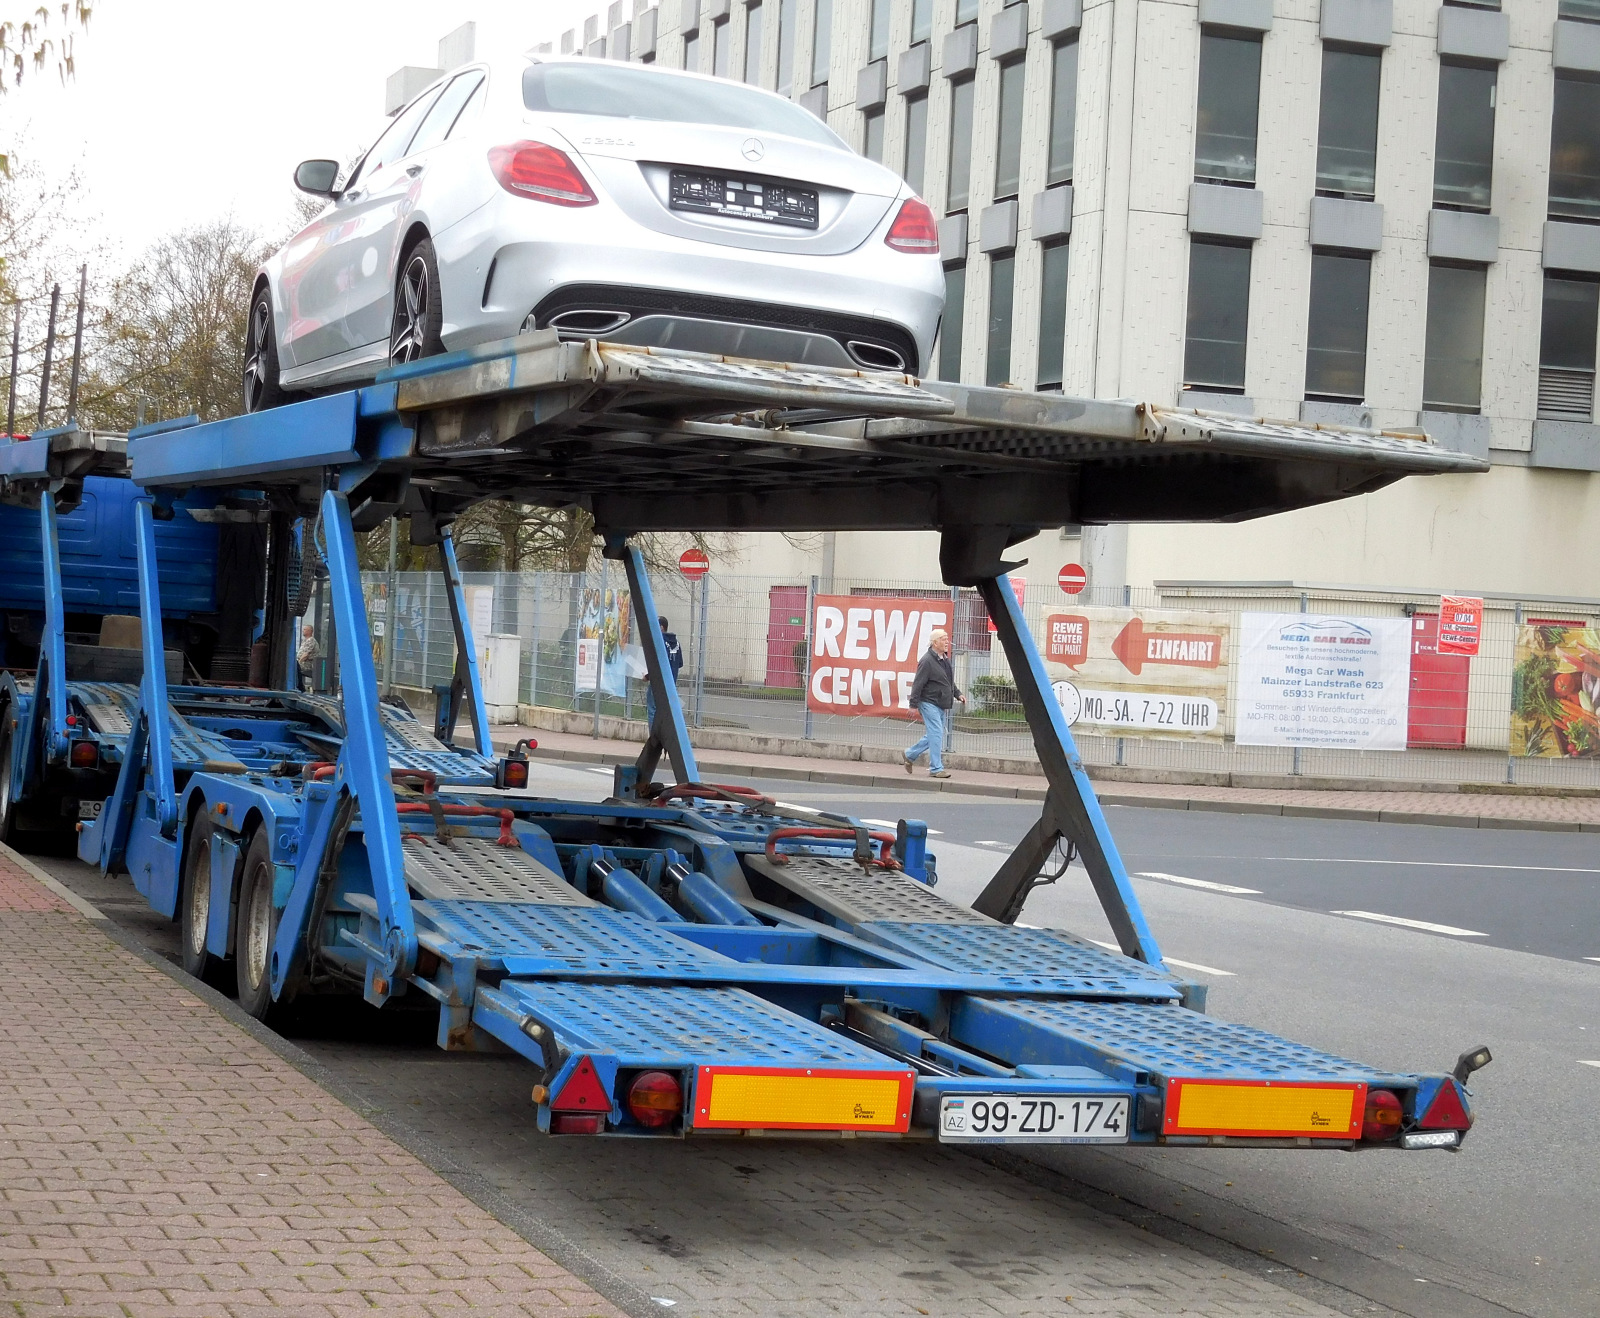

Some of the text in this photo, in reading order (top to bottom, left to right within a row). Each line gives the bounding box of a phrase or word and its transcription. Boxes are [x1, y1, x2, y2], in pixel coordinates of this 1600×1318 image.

[1053, 622, 1083, 634] REWE
[1052, 633, 1082, 645] CENTER
[1280, 634, 1371, 645] MEGA CAR WASH
[1064, 644, 1082, 656] MARKT
[1147, 638, 1215, 662] EINFAHRT
[1266, 644, 1298, 652] Besuchen
[1285, 666, 1364, 677] Mega Car Wash
[812, 666, 916, 709] CENTE
[1261, 677, 1384, 690] Mainzer Landstraße 623
[1283, 689, 1365, 701] 65933 Frankfurt
[1084, 696, 1210, 727] MO.-SA. 7-22 UHR
[1255, 702, 1290, 711] Sommer-
[1291, 704, 1306, 712] und
[948, 1101, 1121, 1133] AZ 99-ZD-174
